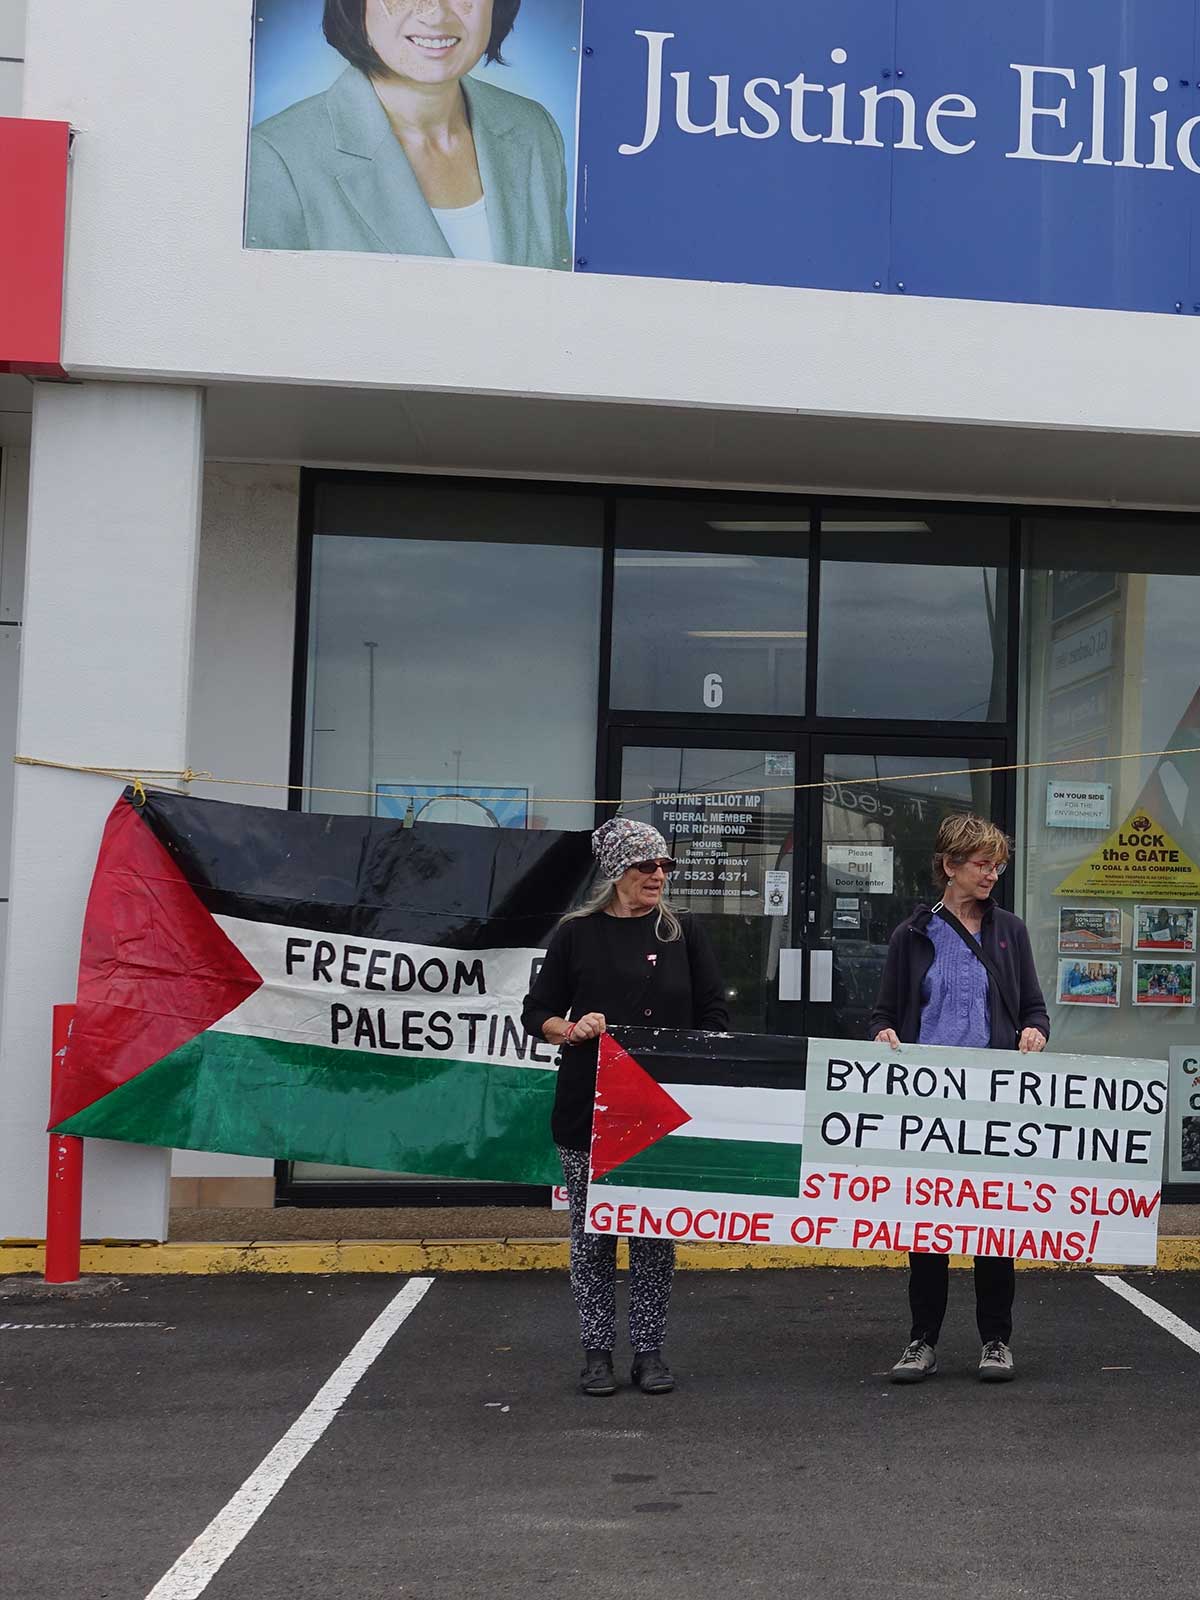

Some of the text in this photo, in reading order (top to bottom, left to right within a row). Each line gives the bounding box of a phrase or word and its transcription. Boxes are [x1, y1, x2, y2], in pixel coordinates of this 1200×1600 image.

[618, 30, 977, 155] Justine
[703, 673, 724, 708] 6
[656, 792, 761, 807] JUSTINE ELLIOT MP
[663, 811, 753, 823] FEDERAL MEMBER
[669, 823, 746, 835] FOR RICHMOND
[1118, 834, 1164, 847] LOCK
[686, 849, 704, 857] 9am
[711, 850, 729, 859] 5pm
[1102, 849, 1179, 863] the GATE
[848, 862, 872, 873] Pull
[684, 871, 715, 881] 5523
[718, 872, 748, 882] 4371
[285, 937, 487, 996] FREEDOM
[825, 1059, 1166, 1115] BYRON FRIENDS
[820, 1112, 1151, 1164] OF PALESTINE
[800, 1172, 1161, 1219] STOP ISRAEL'S SLOW
[590, 1202, 1098, 1263] GENOCIDE OF PALESTINIANS!
